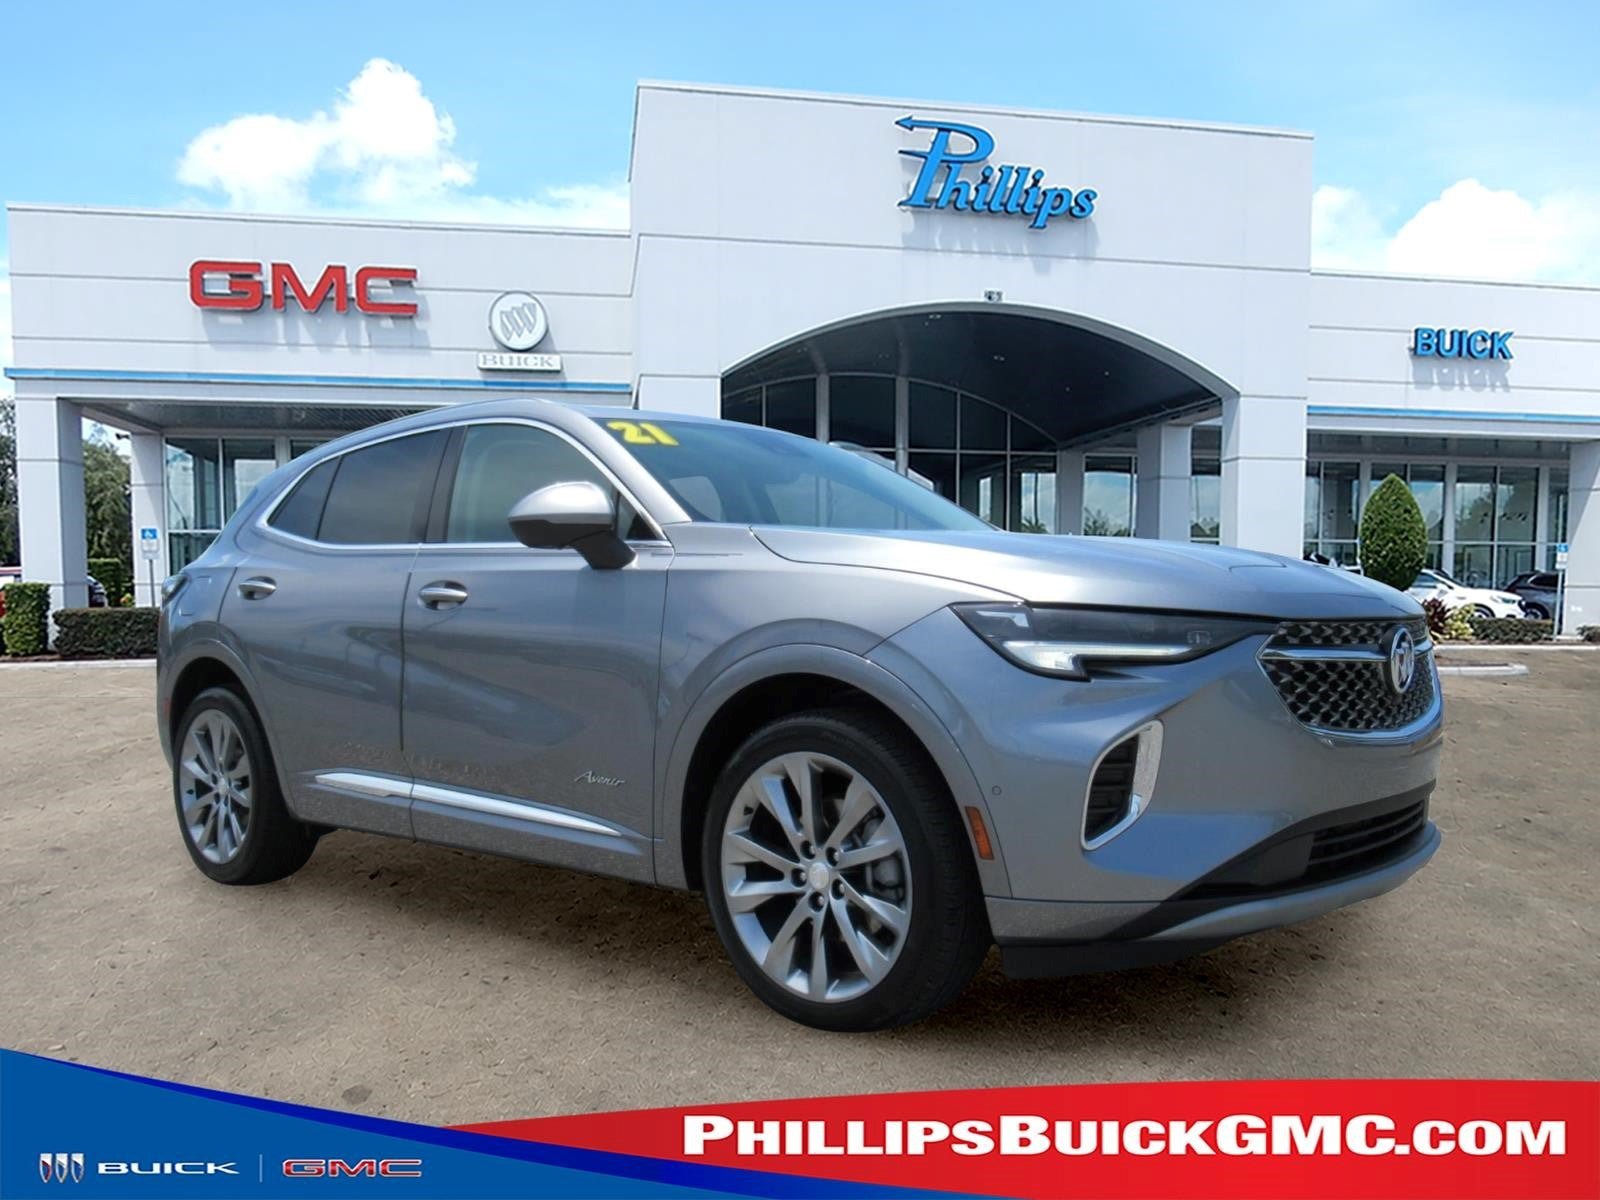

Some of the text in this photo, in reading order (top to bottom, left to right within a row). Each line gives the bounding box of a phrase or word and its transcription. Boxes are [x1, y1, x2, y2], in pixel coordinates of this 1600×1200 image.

[895, 116, 1098, 229] Phillips
[189, 260, 418, 317] GMC
[1413, 327, 1514, 360] BUICK
[482, 353, 556, 368] BUICK
[606, 421, 679, 446] 21
